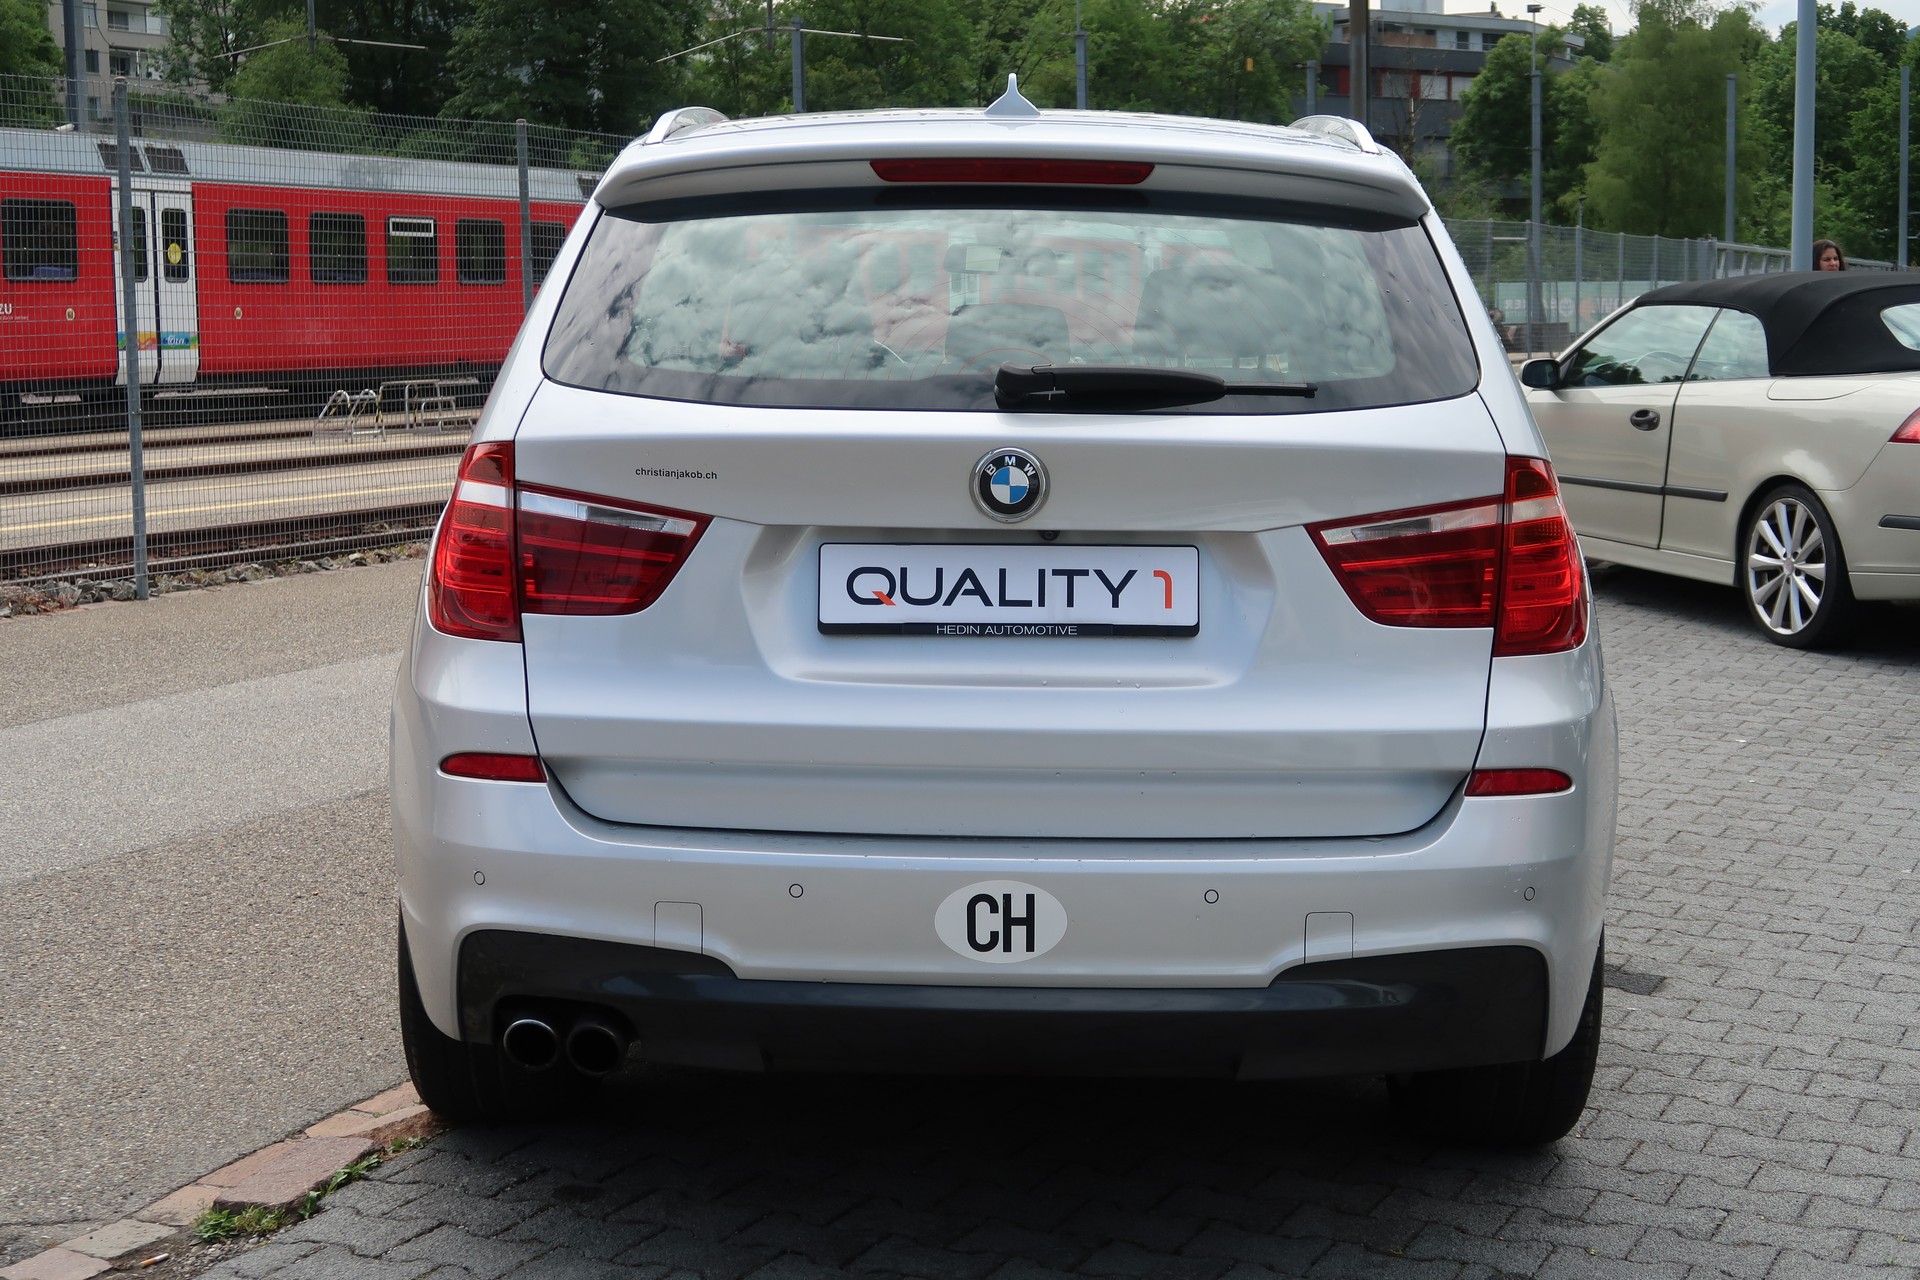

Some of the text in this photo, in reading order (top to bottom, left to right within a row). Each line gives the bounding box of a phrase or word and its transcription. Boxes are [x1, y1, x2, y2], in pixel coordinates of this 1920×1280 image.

[635, 467, 718, 479] christianjakob.ch
[984, 455, 1036, 476] BMW
[846, 566, 1173, 609] QUALITY 1
[936, 625, 1078, 635] HEDIN AUTOMOTIVE
[966, 893, 1035, 953] CH
